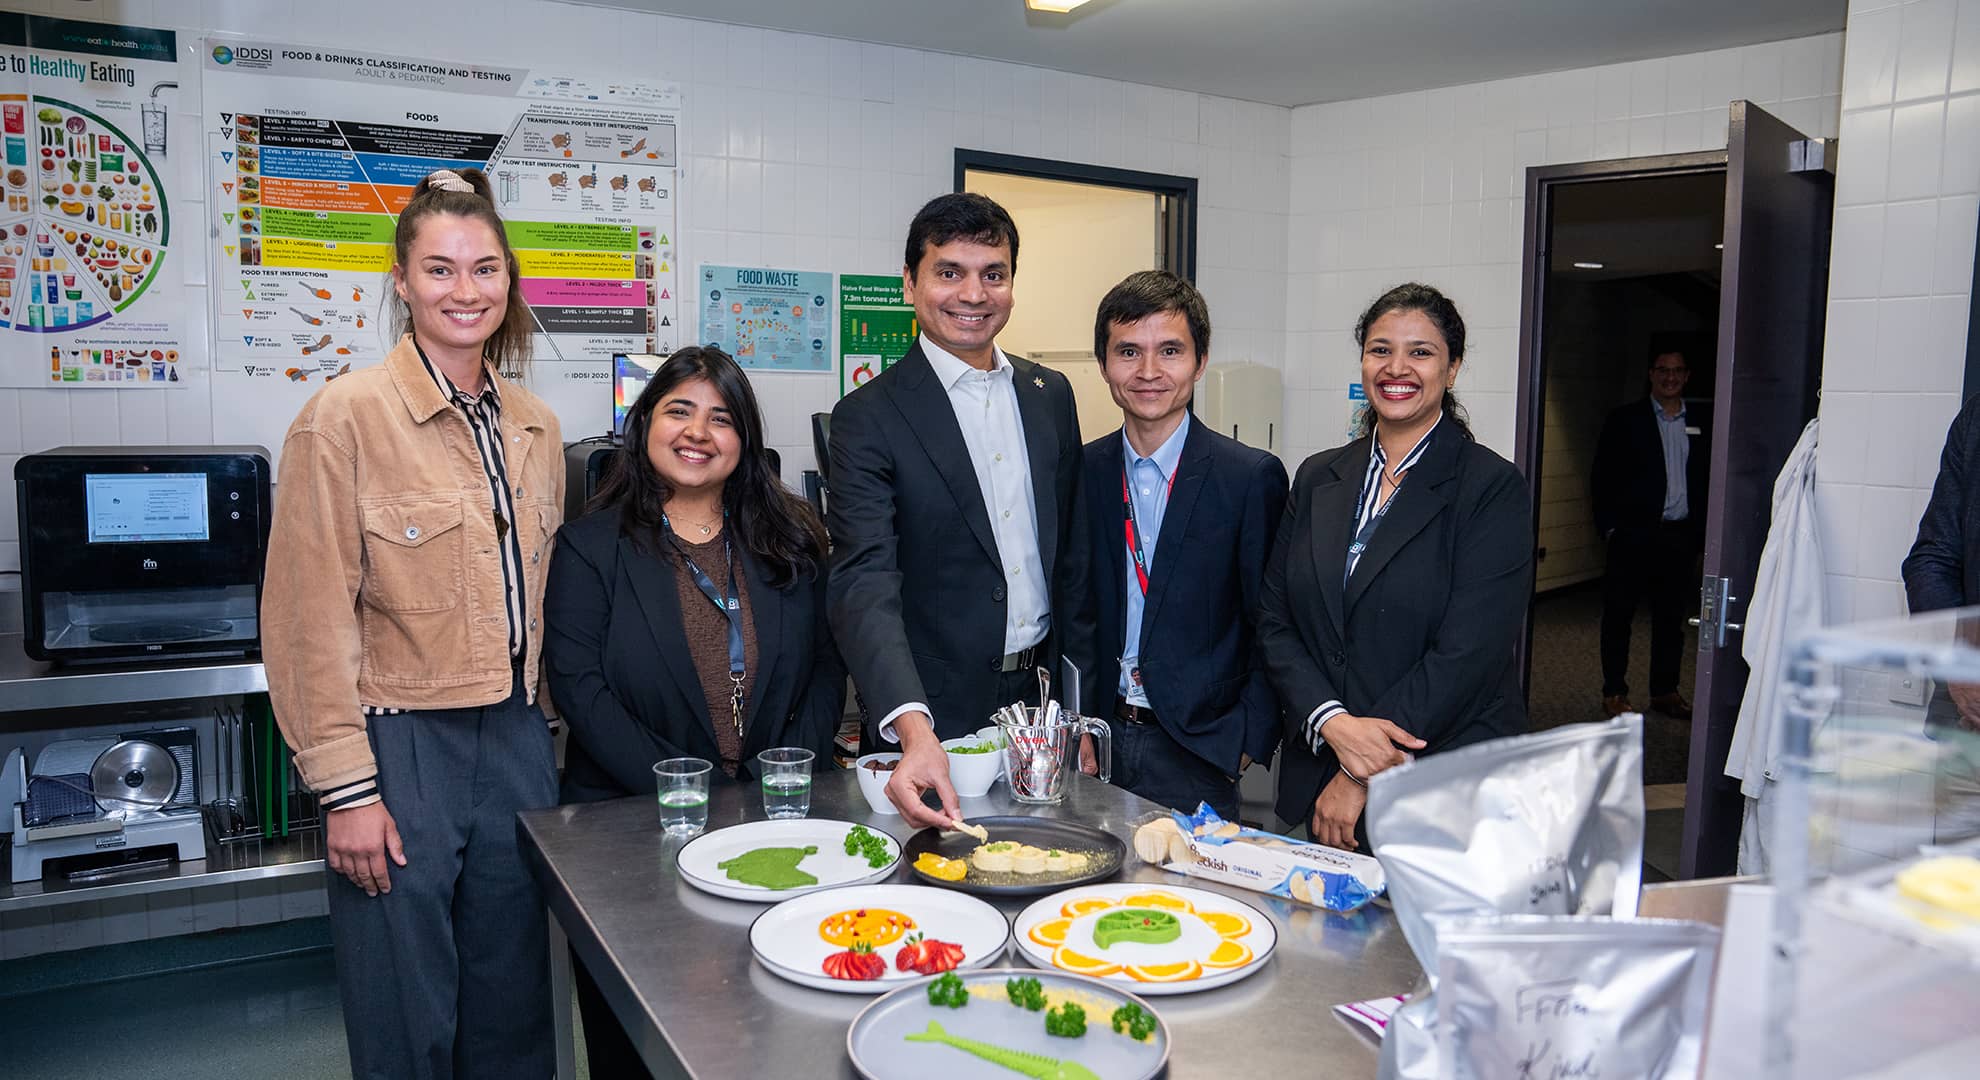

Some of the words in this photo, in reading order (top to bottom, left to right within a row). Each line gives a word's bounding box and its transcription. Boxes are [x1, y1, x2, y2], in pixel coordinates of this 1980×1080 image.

[236, 48, 272, 60] IDDSI
[12, 54, 25, 74] to
[30, 54, 86, 82] Healthy
[90, 62, 134, 88] Eating
[282, 50, 312, 60] FOOD
[315, 52, 322, 62] &
[325, 53, 363, 65] DRINKS
[366, 58, 446, 75] CLASSIFICATION
[448, 69, 468, 78] AND
[472, 71, 511, 82] TESTING
[355, 68, 386, 78] ADULT
[399, 72, 446, 85] PEDIATRIC
[406, 112, 439, 122] FOODS
[608, 123, 648, 131] INSTRUCTIONS
[537, 161, 580, 169] INSTRUCTIONS
[737, 270, 762, 285] FOOD
[765, 272, 798, 287] WASTE
[1232, 865, 1262, 878] ORIGINAL
